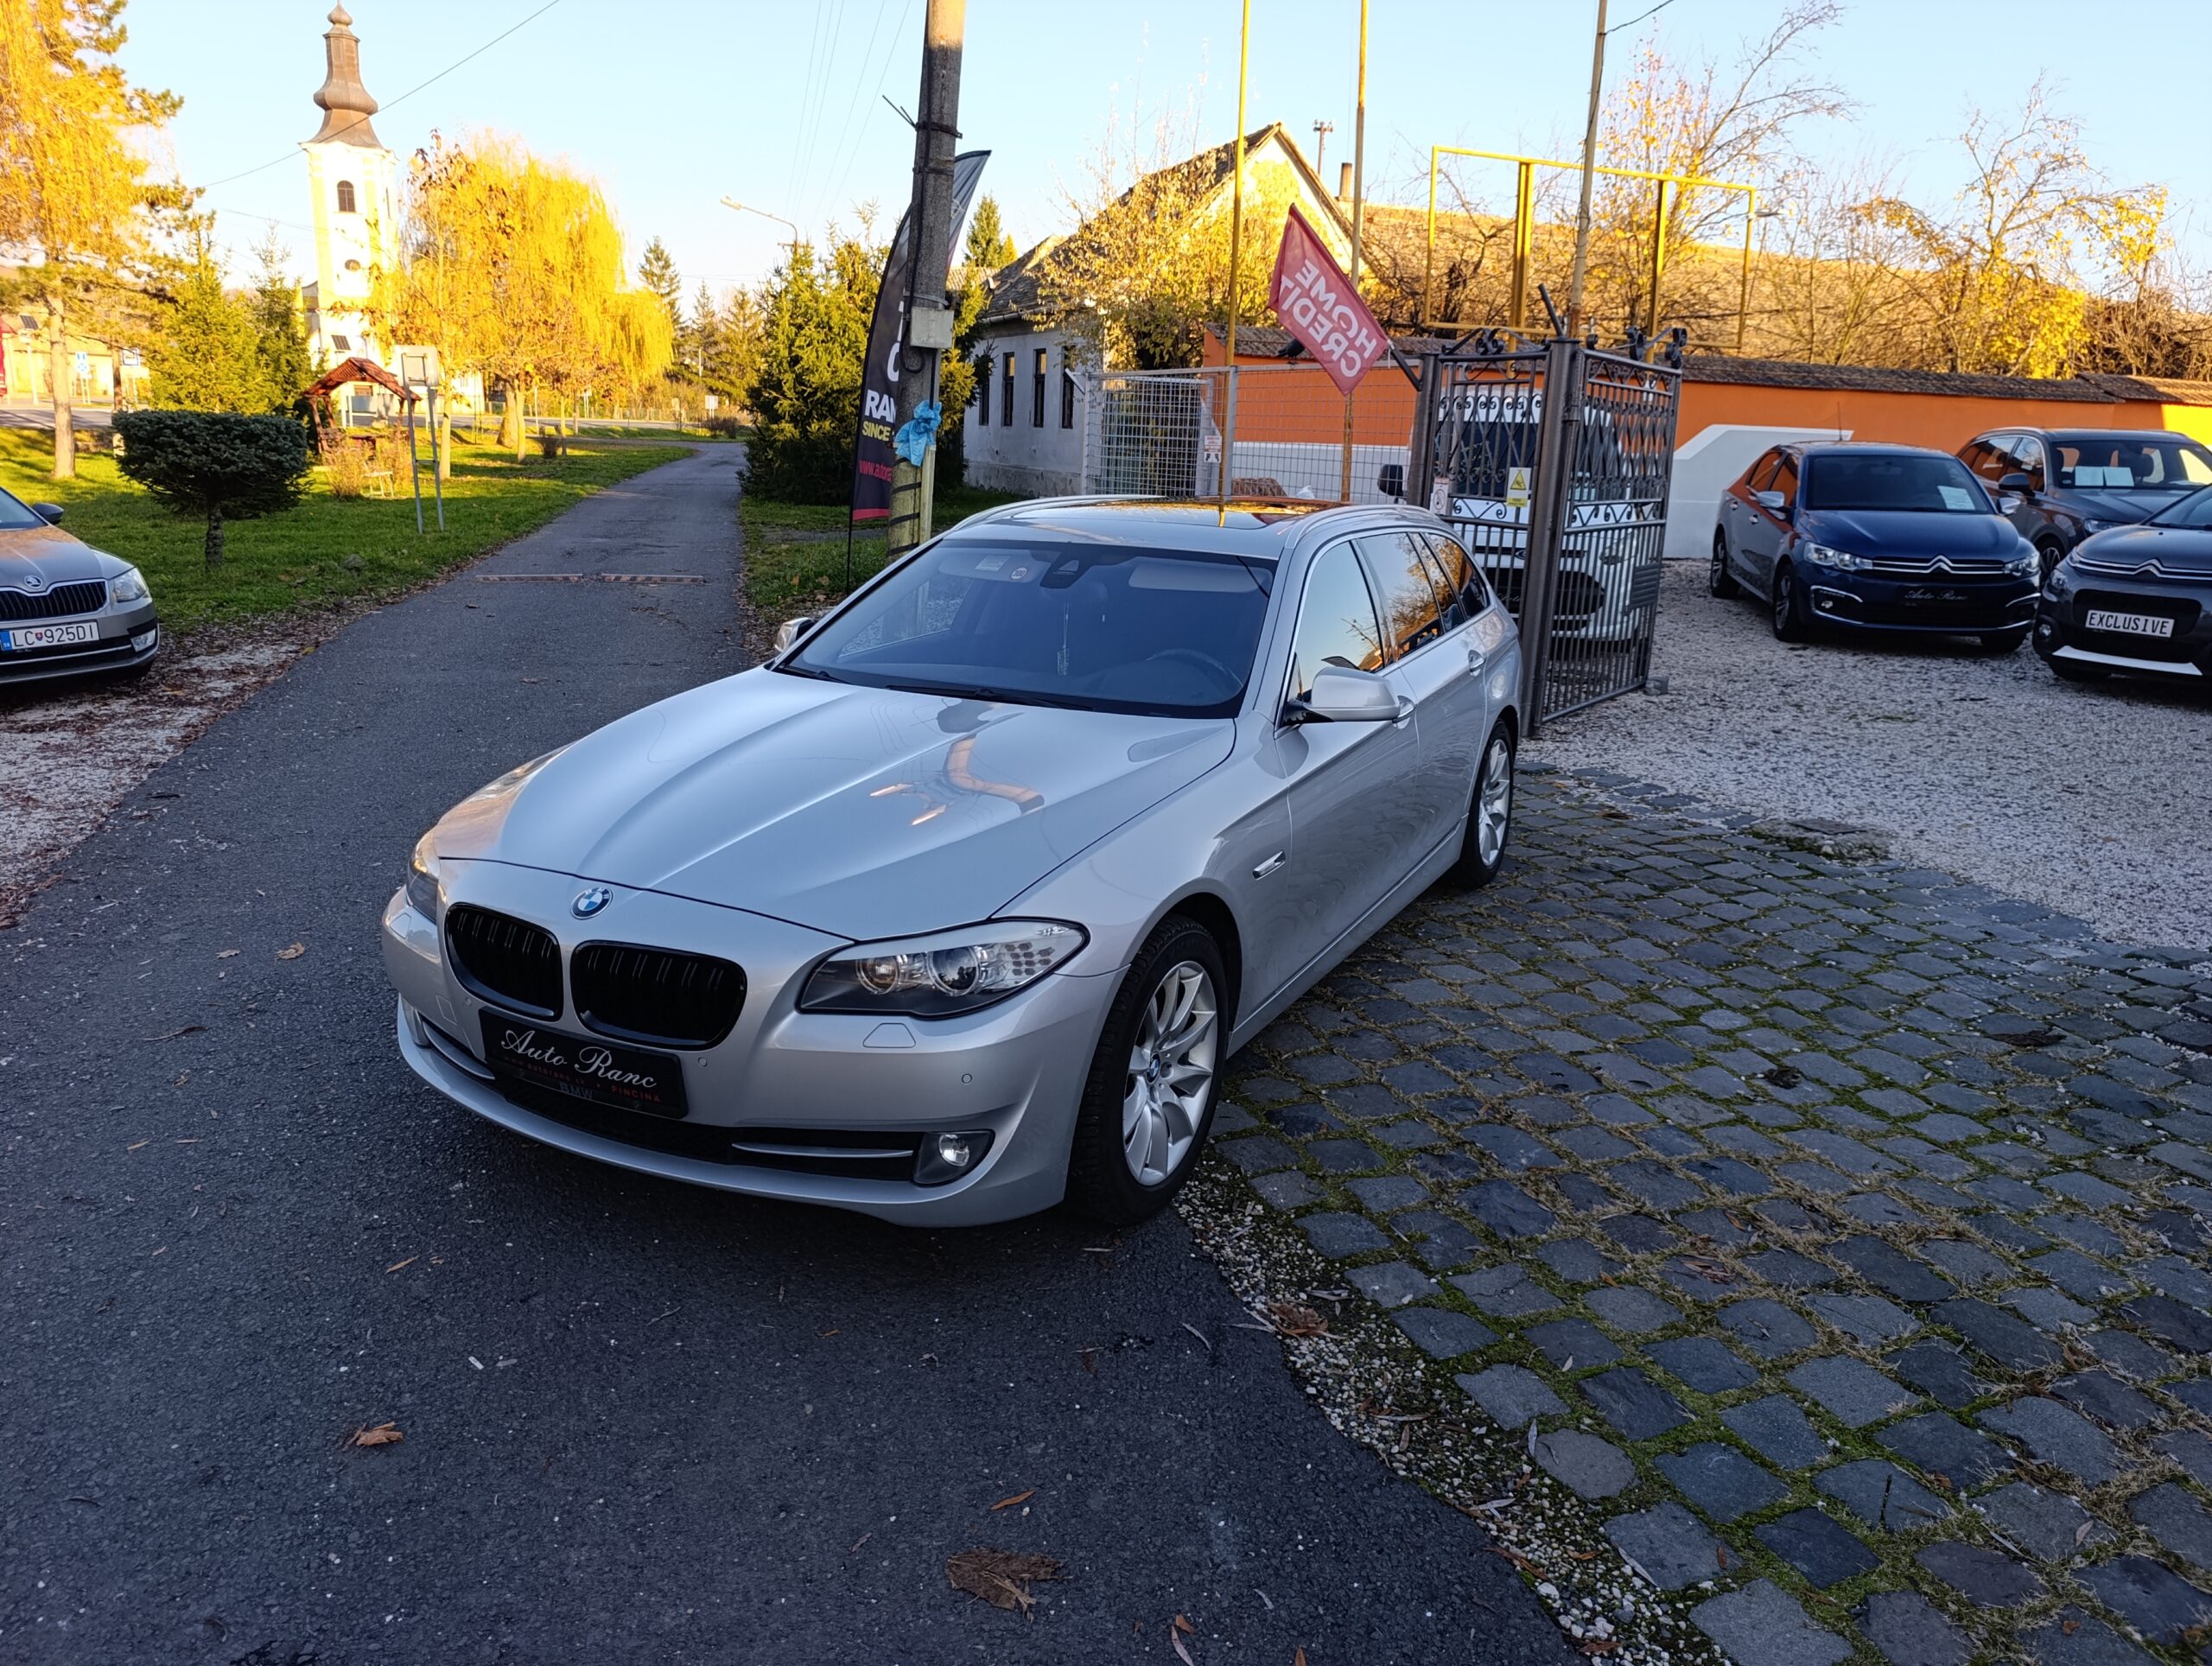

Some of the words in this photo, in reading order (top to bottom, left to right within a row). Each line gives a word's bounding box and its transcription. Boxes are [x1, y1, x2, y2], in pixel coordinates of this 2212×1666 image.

[862, 421, 891, 442] SINCE
[2088, 612, 2170, 635] EXCLUSIVE
[12, 631, 35, 647] LC
[44, 624, 93, 643] 925DI
[501, 1030, 567, 1065] Auto
[574, 1046, 657, 1088] Ranc
[560, 1081, 594, 1100] BMW
